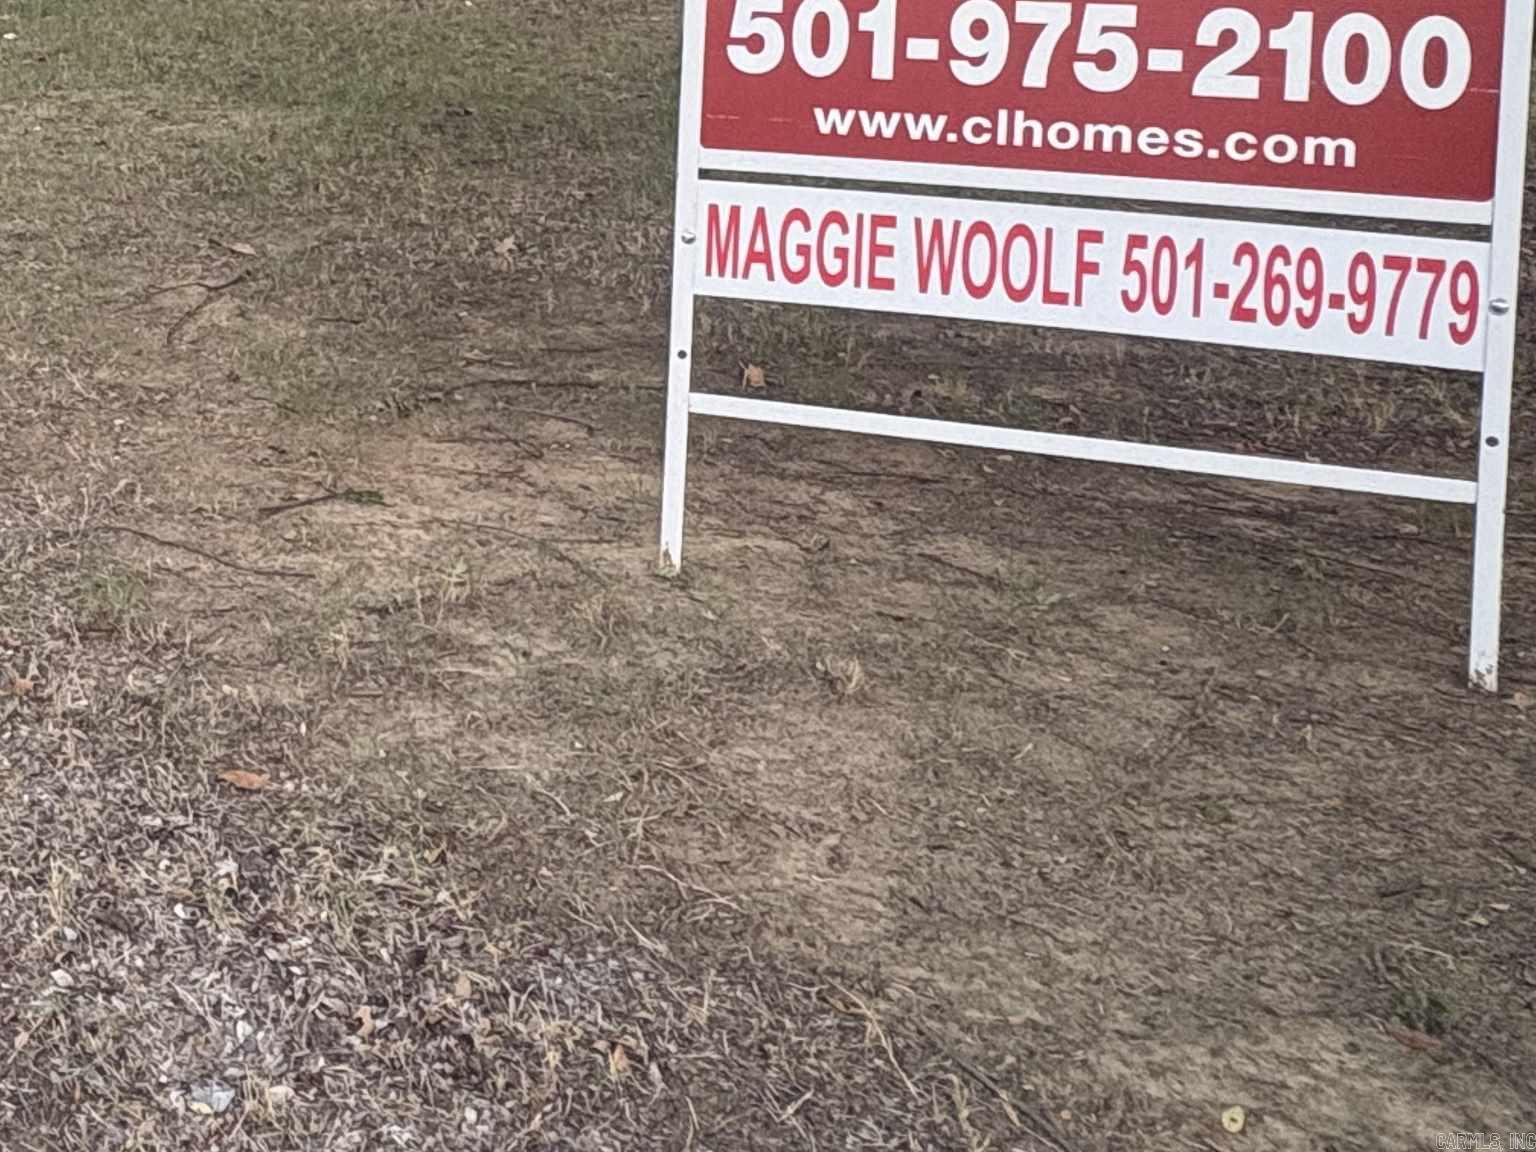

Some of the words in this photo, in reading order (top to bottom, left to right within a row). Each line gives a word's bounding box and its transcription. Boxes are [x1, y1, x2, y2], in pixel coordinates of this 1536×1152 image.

[812, 106, 1358, 169] www.clhomes.com
[705, 203, 897, 291] MAGGIE
[913, 218, 1105, 308] WOOLF
[1120, 232, 1481, 345] 501-269-9779
